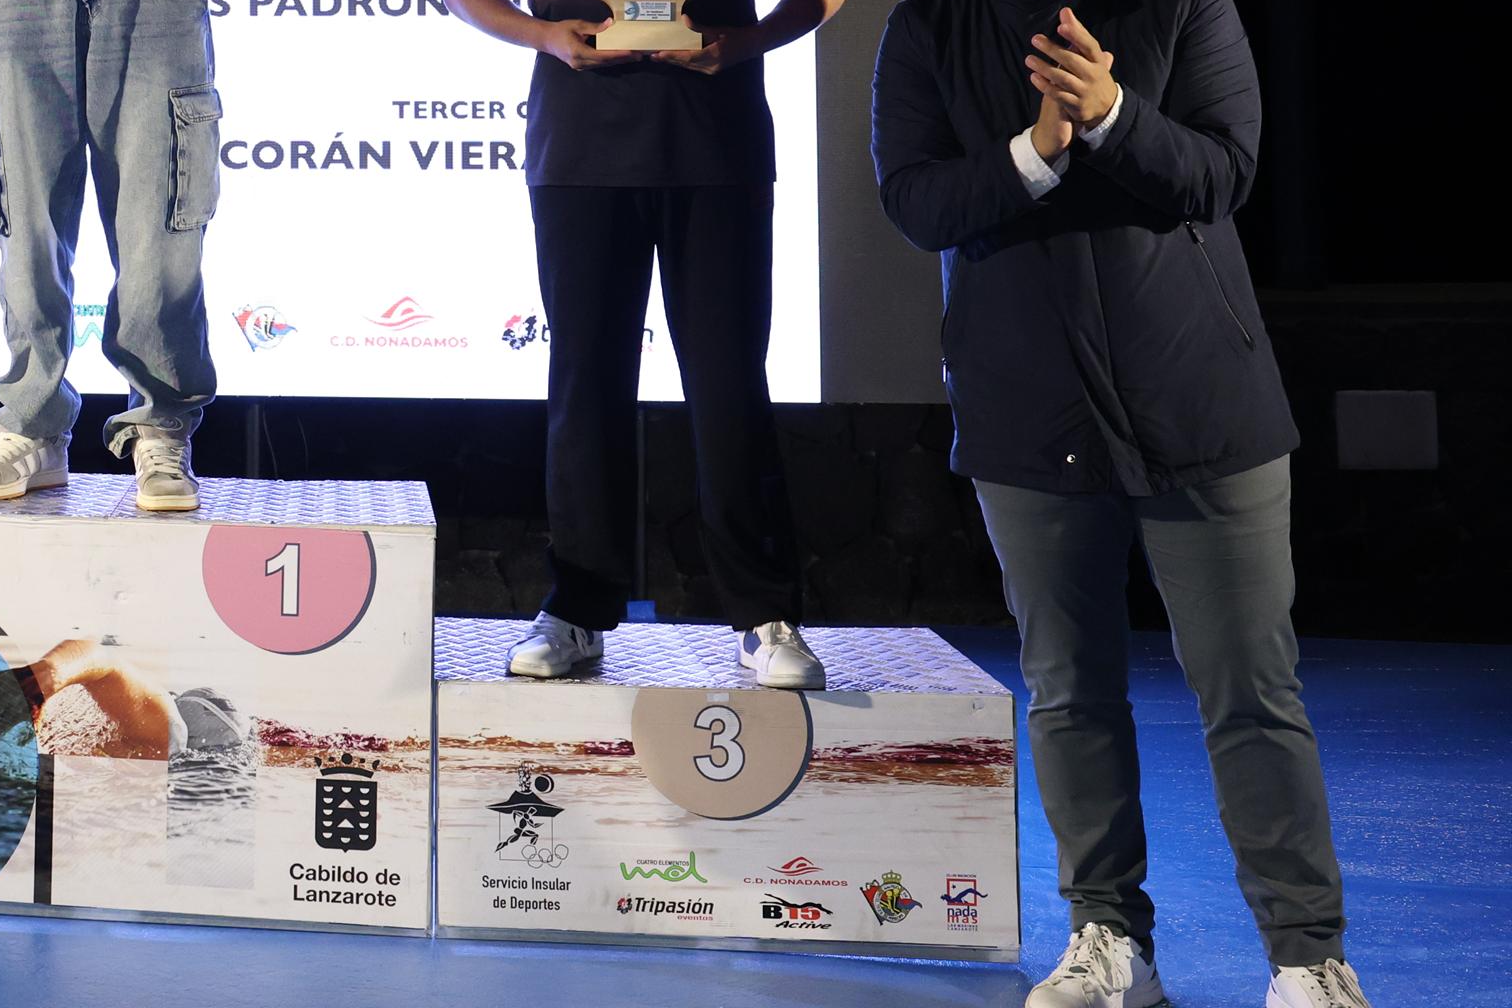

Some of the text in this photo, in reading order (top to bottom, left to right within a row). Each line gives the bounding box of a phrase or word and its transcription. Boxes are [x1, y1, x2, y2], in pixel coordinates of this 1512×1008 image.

[391, 100, 506, 119] TERCER
[220, 132, 526, 170] CORÁN VIER
[329, 335, 469, 348] C.D. NONADAMOS
[264, 542, 301, 617] 1
[693, 704, 746, 783] 3
[289, 863, 401, 886] Cabildo de
[481, 875, 572, 892] Servicio Insular
[743, 877, 849, 888] C.D. NONADAMOS
[292, 884, 397, 907] Lanzarote
[492, 896, 561, 912] de Deportes
[635, 896, 715, 916] Tripasión
[947, 906, 978, 918] nada
[775, 919, 833, 931] Active
